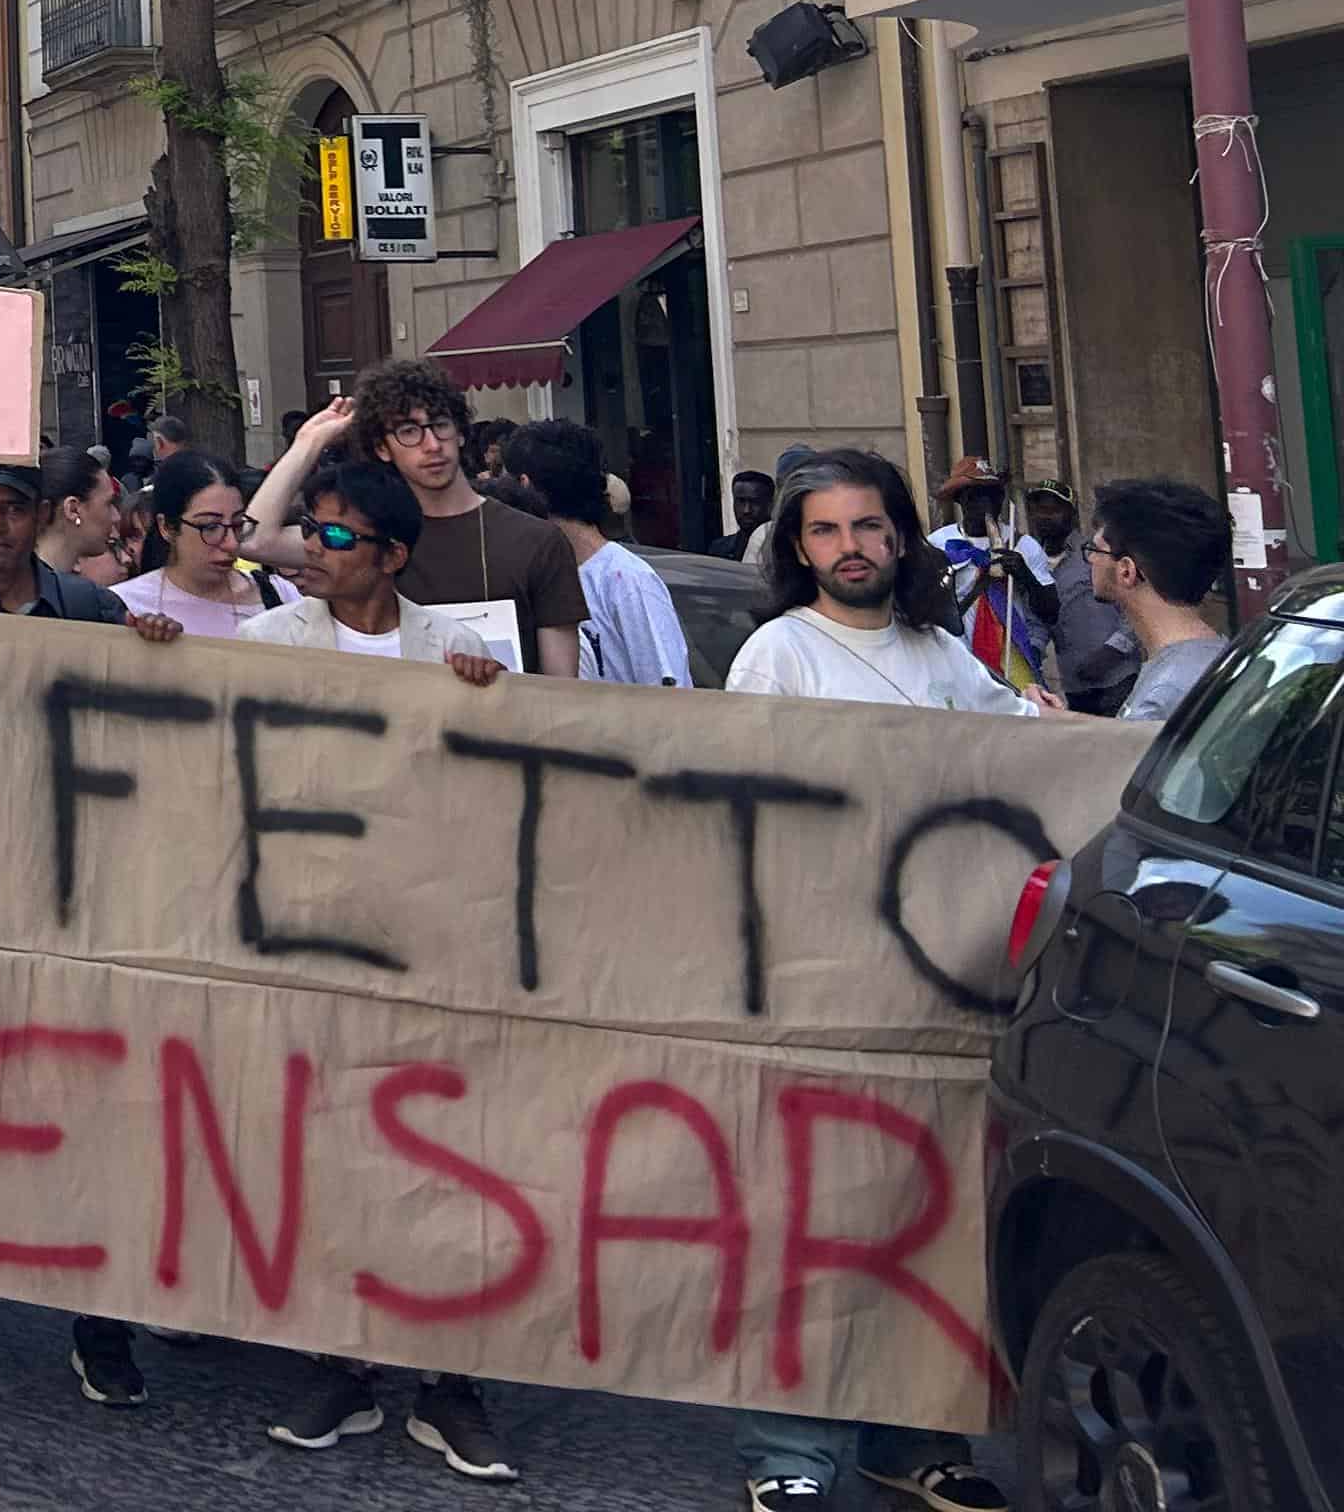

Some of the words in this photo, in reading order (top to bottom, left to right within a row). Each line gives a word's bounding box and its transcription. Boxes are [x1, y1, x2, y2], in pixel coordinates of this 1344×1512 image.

[362, 123, 420, 189] T
[378, 192, 414, 203] VALORI
[364, 205, 427, 216] BOLLATI
